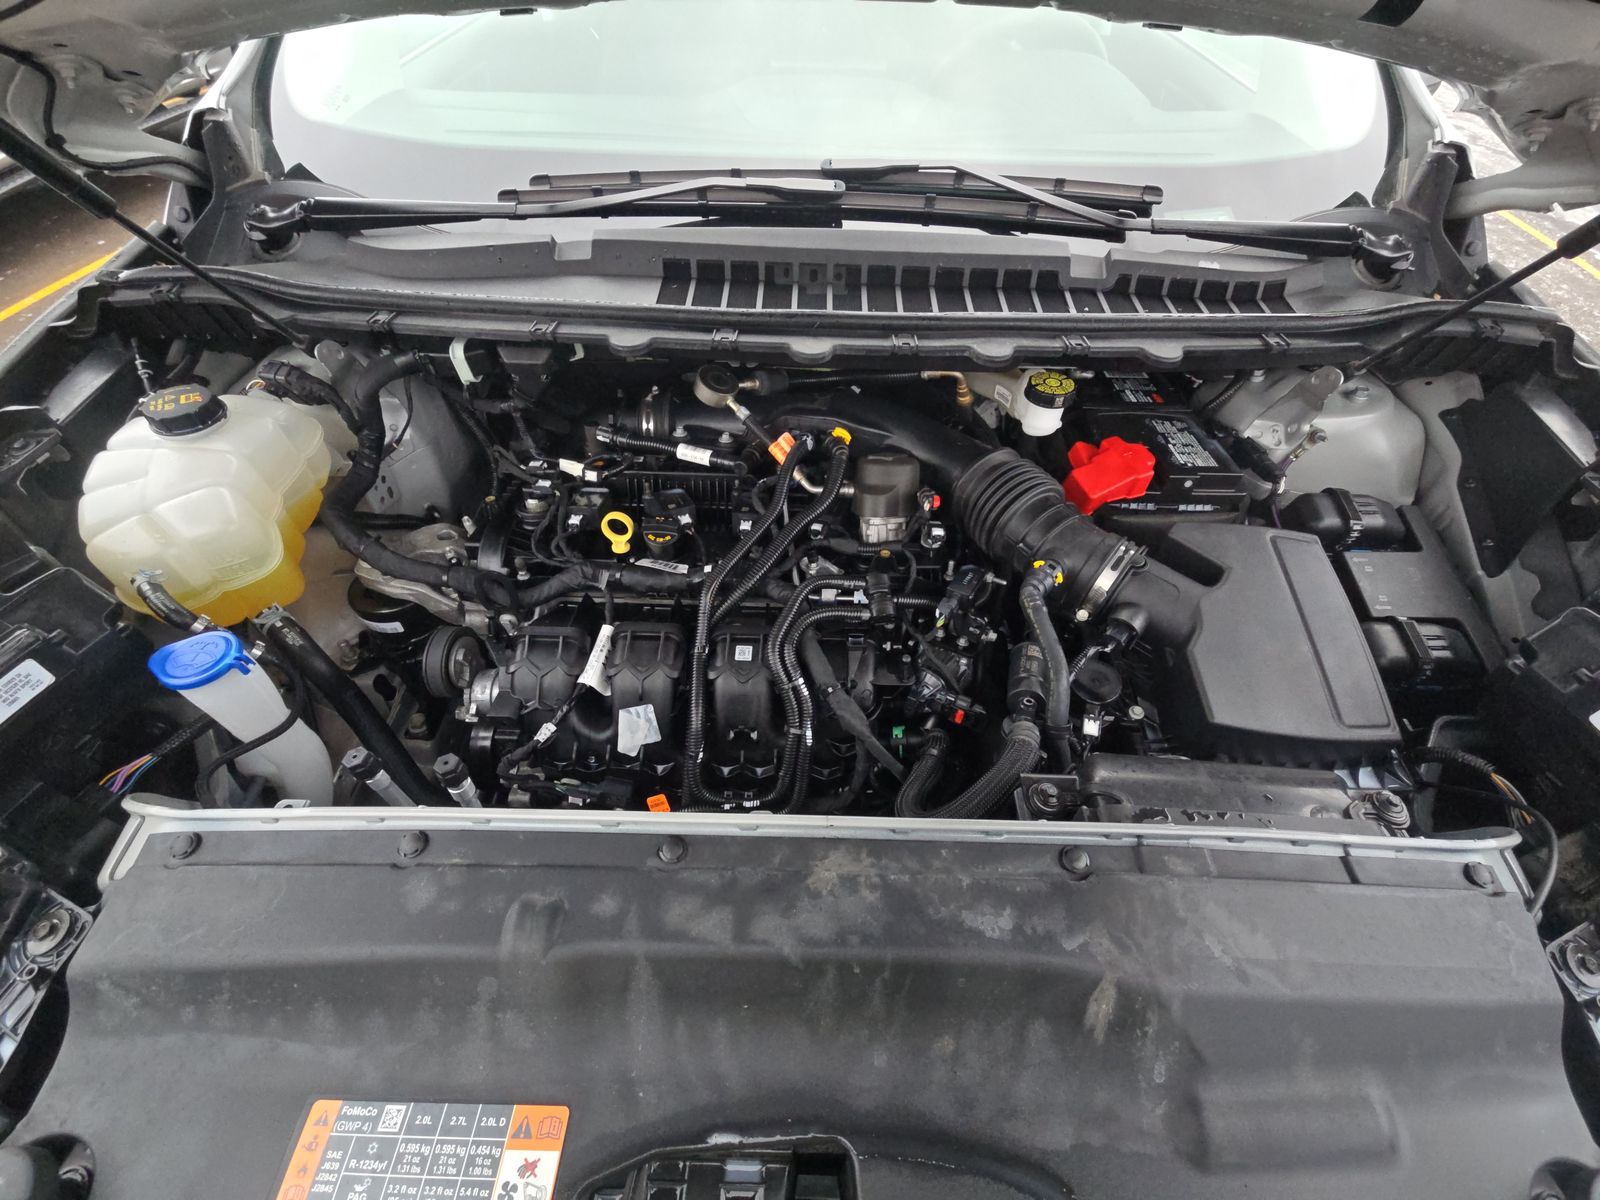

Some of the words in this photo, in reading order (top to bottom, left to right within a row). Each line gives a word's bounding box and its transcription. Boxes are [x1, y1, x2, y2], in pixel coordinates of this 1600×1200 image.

[341, 1106, 378, 1116] FoMoCo
[415, 1115, 432, 1125] 2.0L
[450, 1116, 467, 1126] 2.7L
[480, 1117, 498, 1126] 2.0L
[499, 1118, 506, 1126] D
[333, 1121, 361, 1132] (GWP
[362, 1122, 372, 1133] 4)
[326, 1150, 343, 1159] SAE
[400, 1143, 420, 1153] 0.595
[420, 1144, 431, 1156] kg
[434, 1144, 455, 1154] 0.595
[456, 1145, 466, 1156] kg
[470, 1145, 491, 1156] 0.454
[491, 1146, 502, 1158] kg
[321, 1162, 340, 1170] J639
[348, 1159, 388, 1173] R-1234yf
[387, 1184, 400, 1194] 3.2
[400, 1185, 407, 1194] fl
[424, 1186, 436, 1194] 3.2
[437, 1186, 444, 1195] fl
[444, 1188, 454, 1196] oz
[460, 1187, 472, 1196] 5.4
[472, 1188, 479, 1196] fl
[480, 1189, 490, 1197] oz
